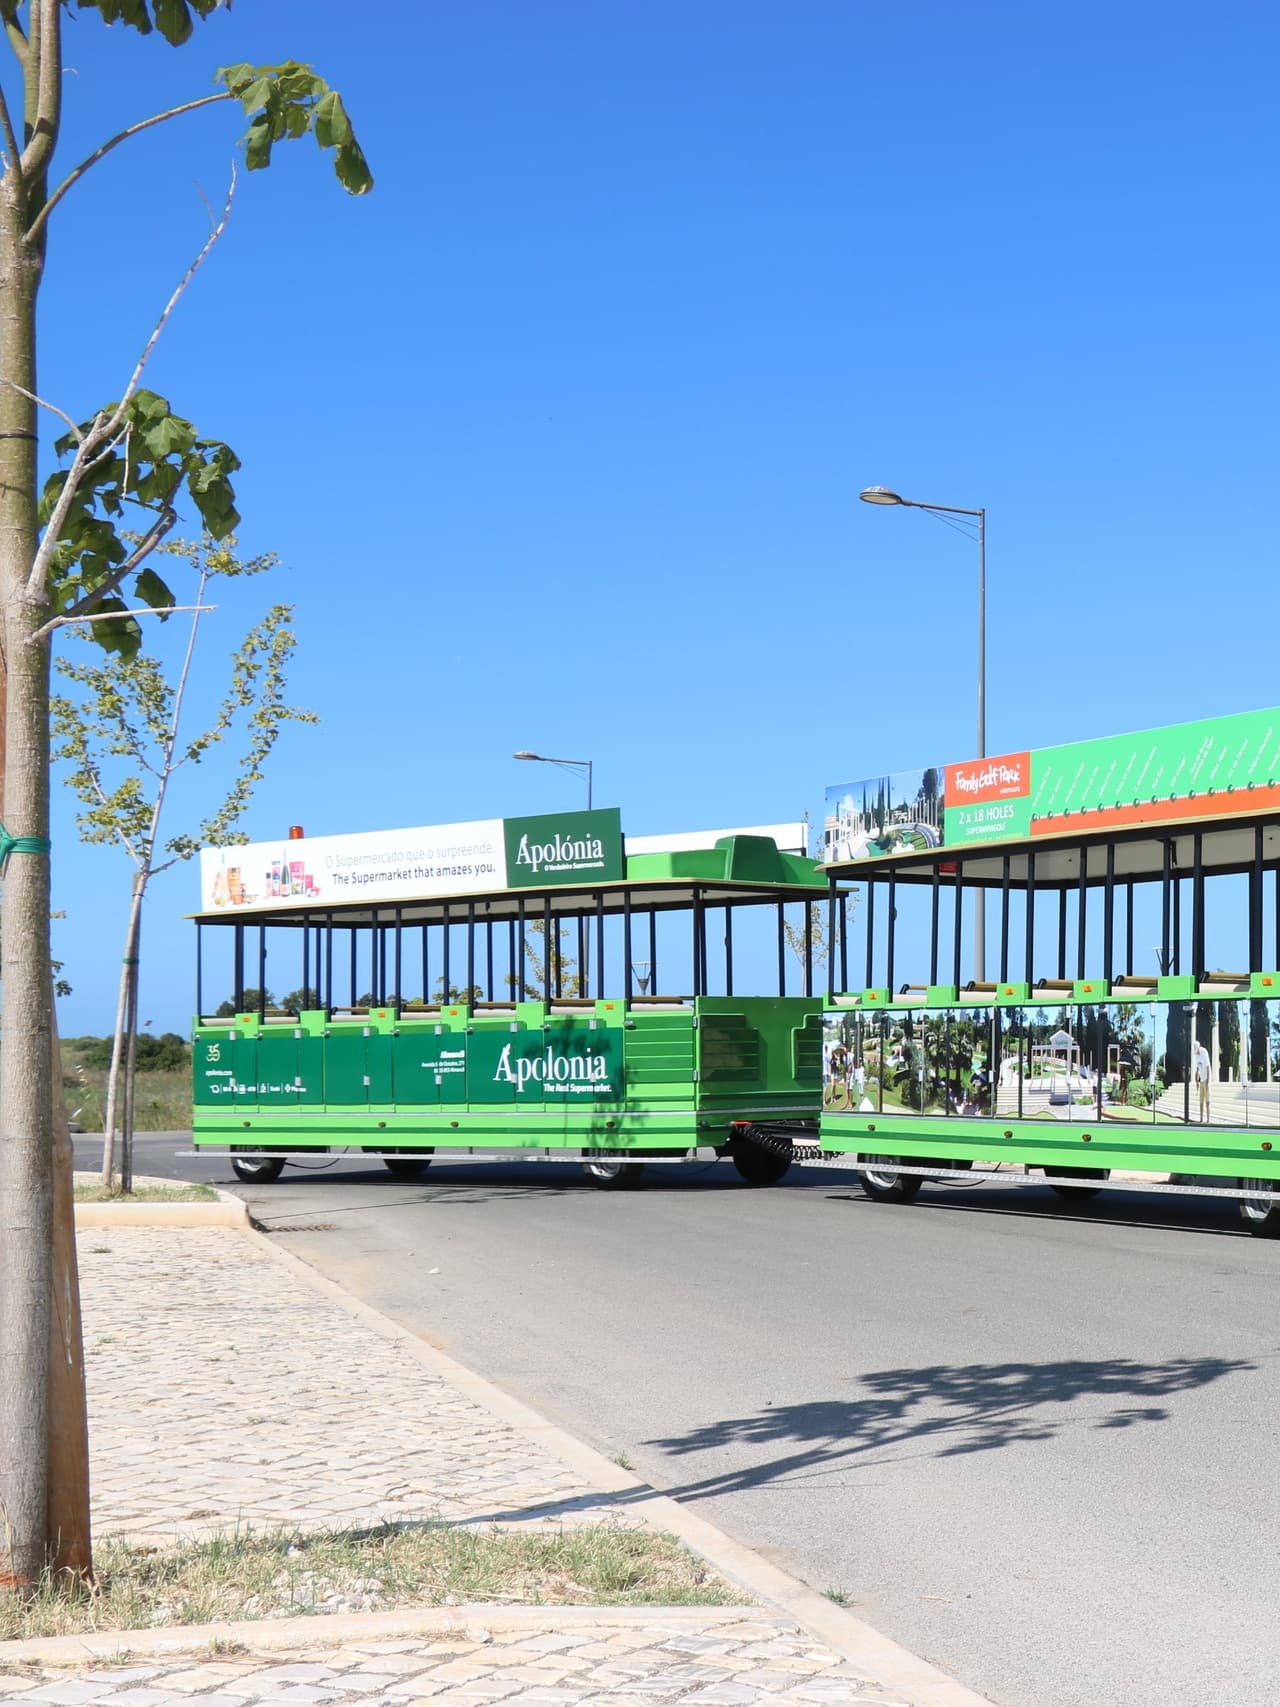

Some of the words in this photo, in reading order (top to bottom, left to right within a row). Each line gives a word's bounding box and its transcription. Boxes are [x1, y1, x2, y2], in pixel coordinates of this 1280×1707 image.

[959, 812, 965, 824] 2
[974, 808, 984, 822] 18
[987, 804, 1014, 819] HOLES
[336, 850, 404, 868] Supermercado
[406, 849, 424, 862] que
[515, 833, 604, 872] Apolónia
[332, 873, 349, 885] The
[352, 868, 412, 886] Supermarket
[414, 867, 434, 878] that
[436, 864, 472, 877] amazes
[475, 862, 496, 877] you.
[492, 1043, 608, 1092] Apolonia
[543, 1083, 555, 1092] The
